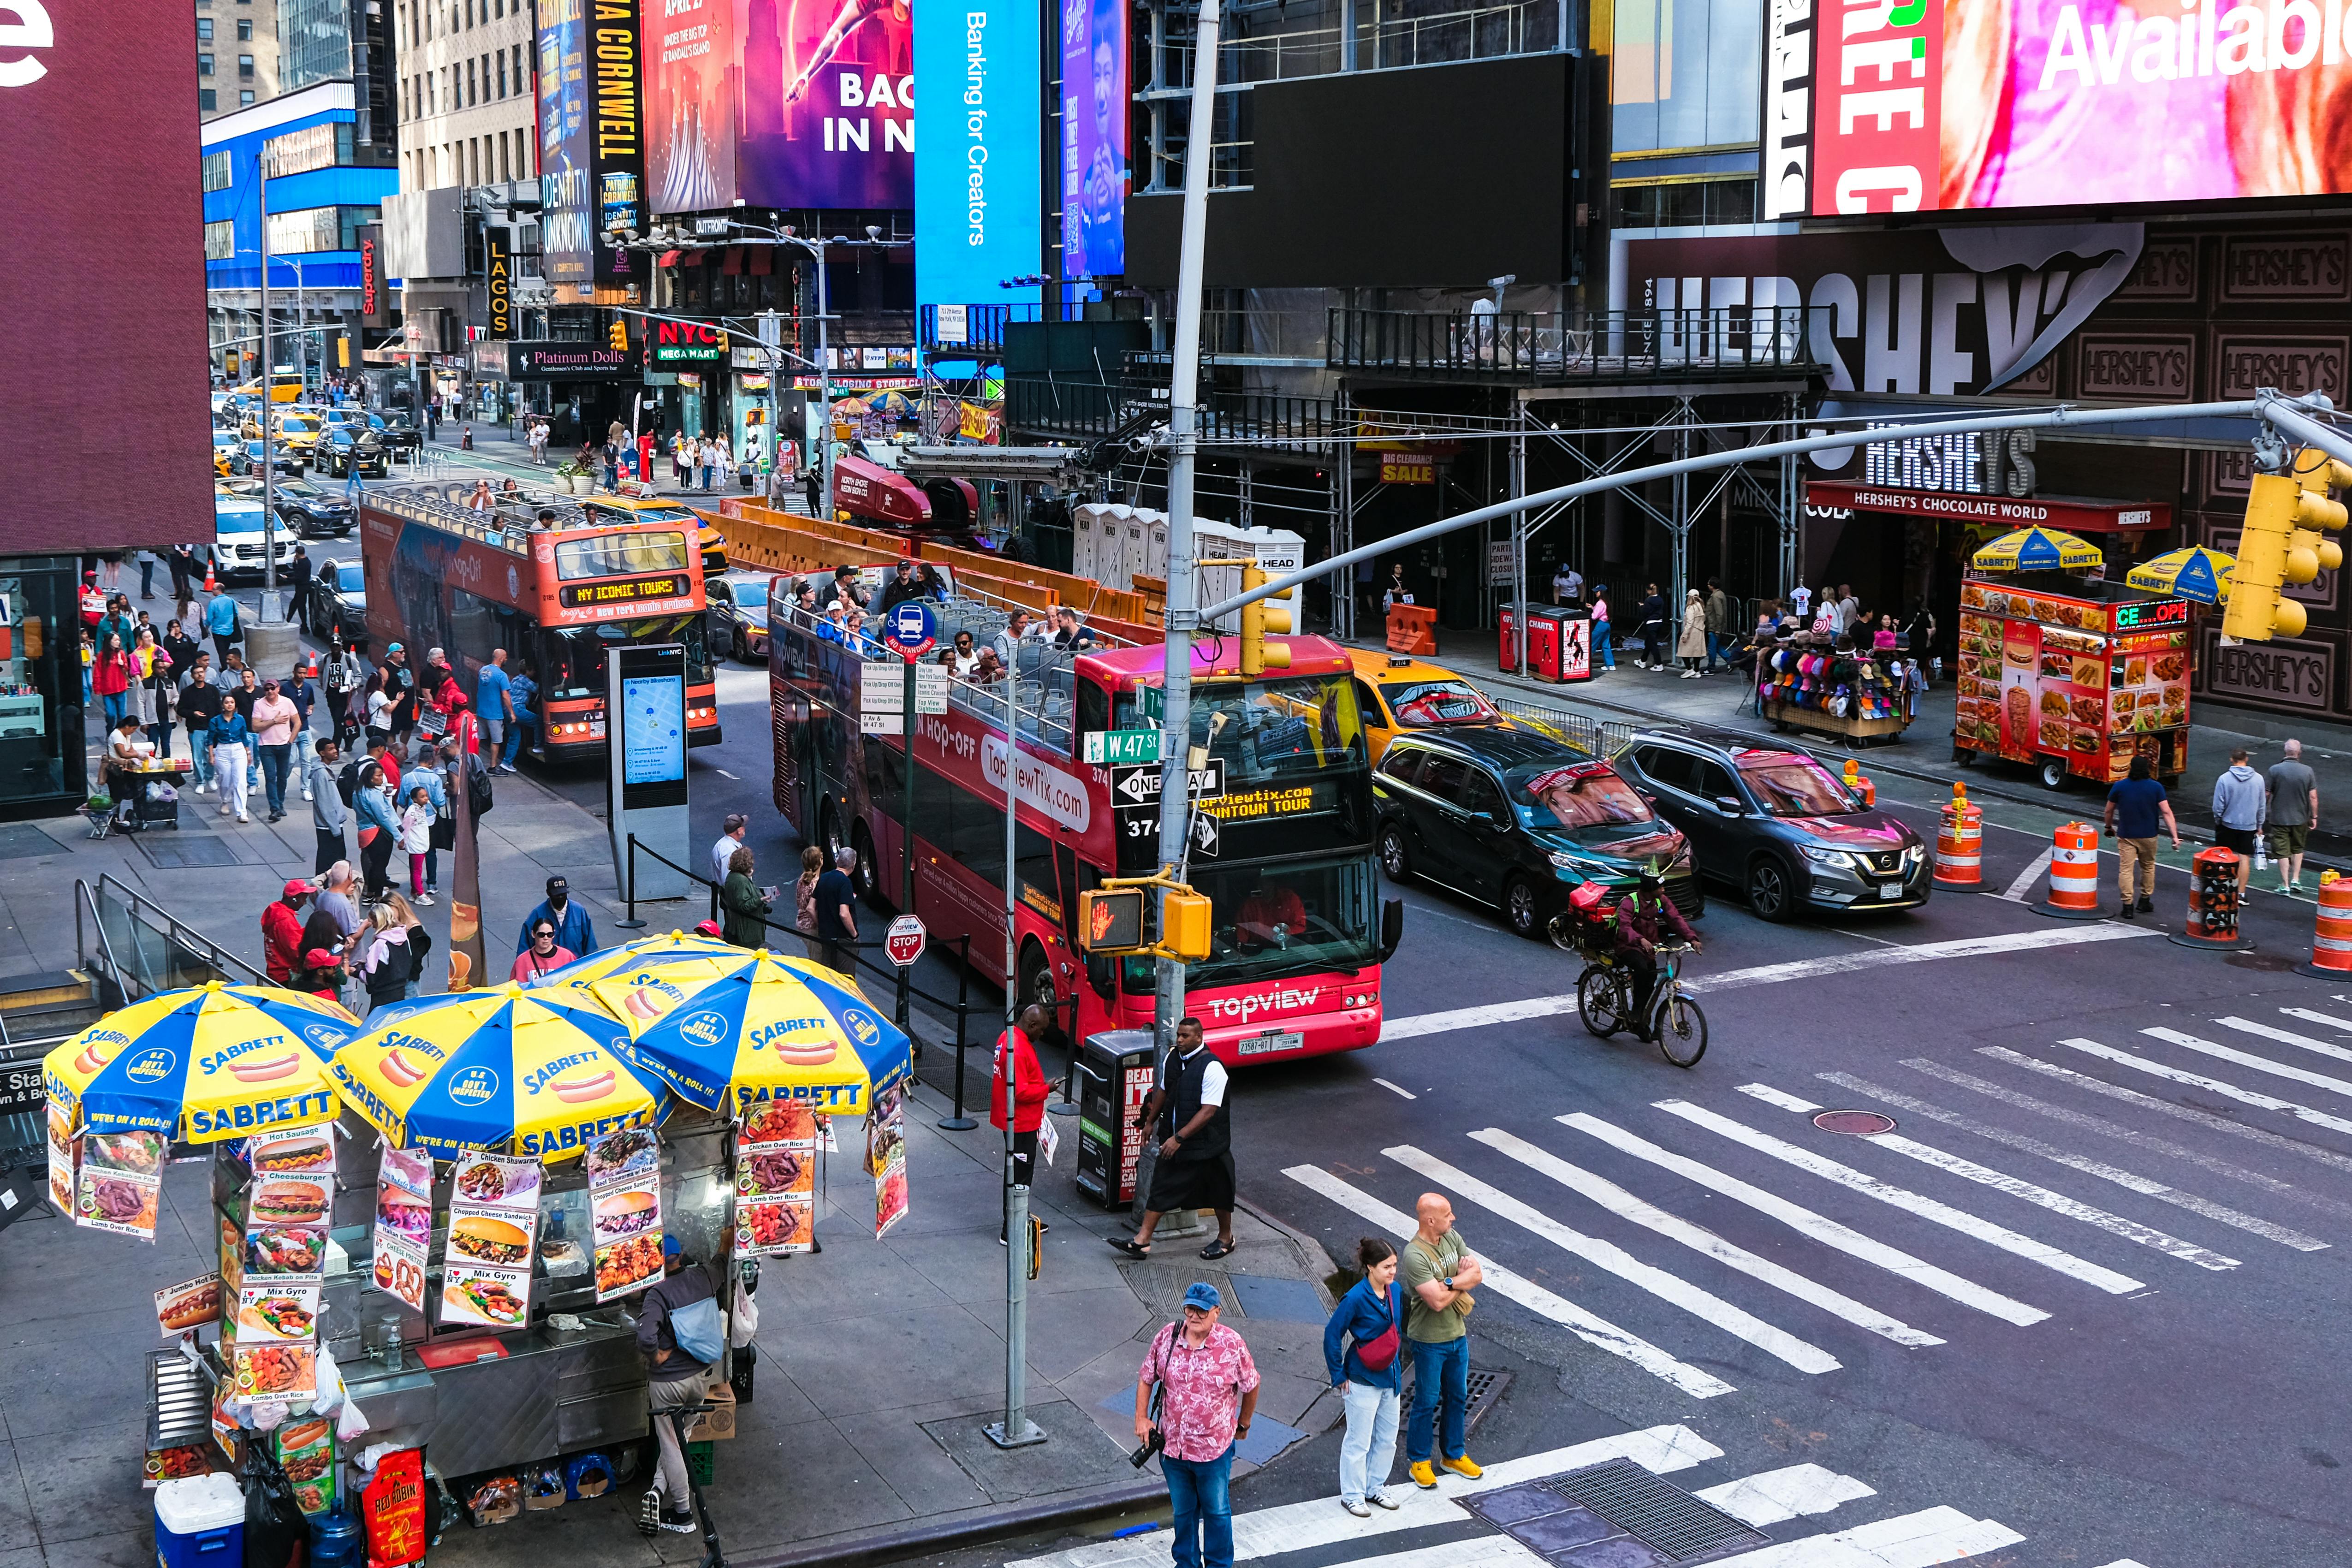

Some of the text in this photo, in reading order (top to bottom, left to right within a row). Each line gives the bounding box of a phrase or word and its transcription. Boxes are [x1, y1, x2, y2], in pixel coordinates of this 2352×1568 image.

[665, 0, 691, 18] APRIL
[664, 24, 707, 47] UNDER THE BIG TOP
[663, 40, 710, 64] AT RANDALL'S ISLAND
[596, 29, 636, 160] CORNWELL
[1066, 96, 1078, 122] FIRST
[824, 118, 869, 152] IN
[964, 12, 988, 247] Banking for Creators
[1066, 146, 1078, 171] FREE
[542, 168, 588, 209] IDENTITY
[606, 178, 636, 191] PATRICIA
[603, 190, 638, 204] CORNWELL
[605, 209, 637, 221] IDENTITY
[605, 218, 637, 230] UNKNOWN
[544, 211, 590, 254] UNKNOWN
[2230, 239, 2347, 288] HERSHEY'S
[492, 242, 508, 332] LAGOS
[659, 321, 716, 344] NYC
[535, 350, 624, 364] Platinum Dolls
[661, 349, 715, 358] MEGA MART
[2085, 345, 2188, 388] HERSHEY'S
[2226, 350, 2337, 397] HERSHEY'S
[986, 415, 1000, 436] OFF
[1384, 453, 1433, 464] BIG CLEARANCE
[1867, 422, 2035, 497] HERSHEY'S
[841, 476, 854, 485] NORTH
[1383, 465, 1432, 481] SALE
[840, 484, 852, 493] NEON
[852, 486, 861, 495] SIGN
[1854, 492, 2048, 520] HERSHEY'S CHOCOLATE WORLD
[1080, 519, 1089, 531] HEAD
[2118, 510, 2151, 525] HERSHEY'S
[1105, 526, 1115, 536] HEAD
[1130, 528, 1140, 539] HEAD
[1155, 532, 1165, 543] HEAD
[1209, 550, 1227, 559] HEAD
[1977, 558, 2016, 567] SABRETT
[2063, 554, 2098, 564] SABRETT
[1263, 559, 1294, 568] HEAD
[577, 580, 673, 601] NY ICONIC TOURS
[597, 607, 614, 617] New
[616, 604, 635, 615] York
[636, 601, 661, 613] Iconic
[1529, 620, 1555, 631] CHARTS.
[889, 638, 932, 654] NO STANDING
[2214, 647, 2324, 697] HERSHEY'S
[1150, 692, 1155, 713] 7
[1109, 734, 1157, 758] W 47 St
[988, 744, 1082, 819] TopiewTix.com
[893, 936, 918, 948] STOP
[902, 948, 907, 957] 1
[750, 1018, 826, 1051] SABRETT
[199, 1035, 285, 1075] SABRETT
[378, 1032, 446, 1062] SABRETT
[523, 1051, 599, 1095] SABRETT
[1126, 1068, 1153, 1084] BEAT
[452, 1087, 491, 1099] INSPECTED
[462, 1080, 487, 1090] GOV'T
[17, 1092, 26, 1102] &
[1125, 1083, 1153, 1105] IT
[191, 1089, 332, 1134] SABRETT
[91, 1113, 159, 1127] WE'RE ON A ROLL
[269, 1127, 319, 1140] Hot Sausage
[1082, 1119, 1110, 1142] TIMES SQUARE
[481, 1153, 539, 1165] Chicken Shawarma
[269, 1172, 326, 1182] Cheeseburger
[454, 1208, 532, 1221] Chopped Cheese Sandwich
[748, 1247, 768, 1255] Combo
[494, 1271, 517, 1281] Gyro
[285, 1288, 308, 1296] Gyro
[375, 1482, 417, 1514] RED ROBIN
